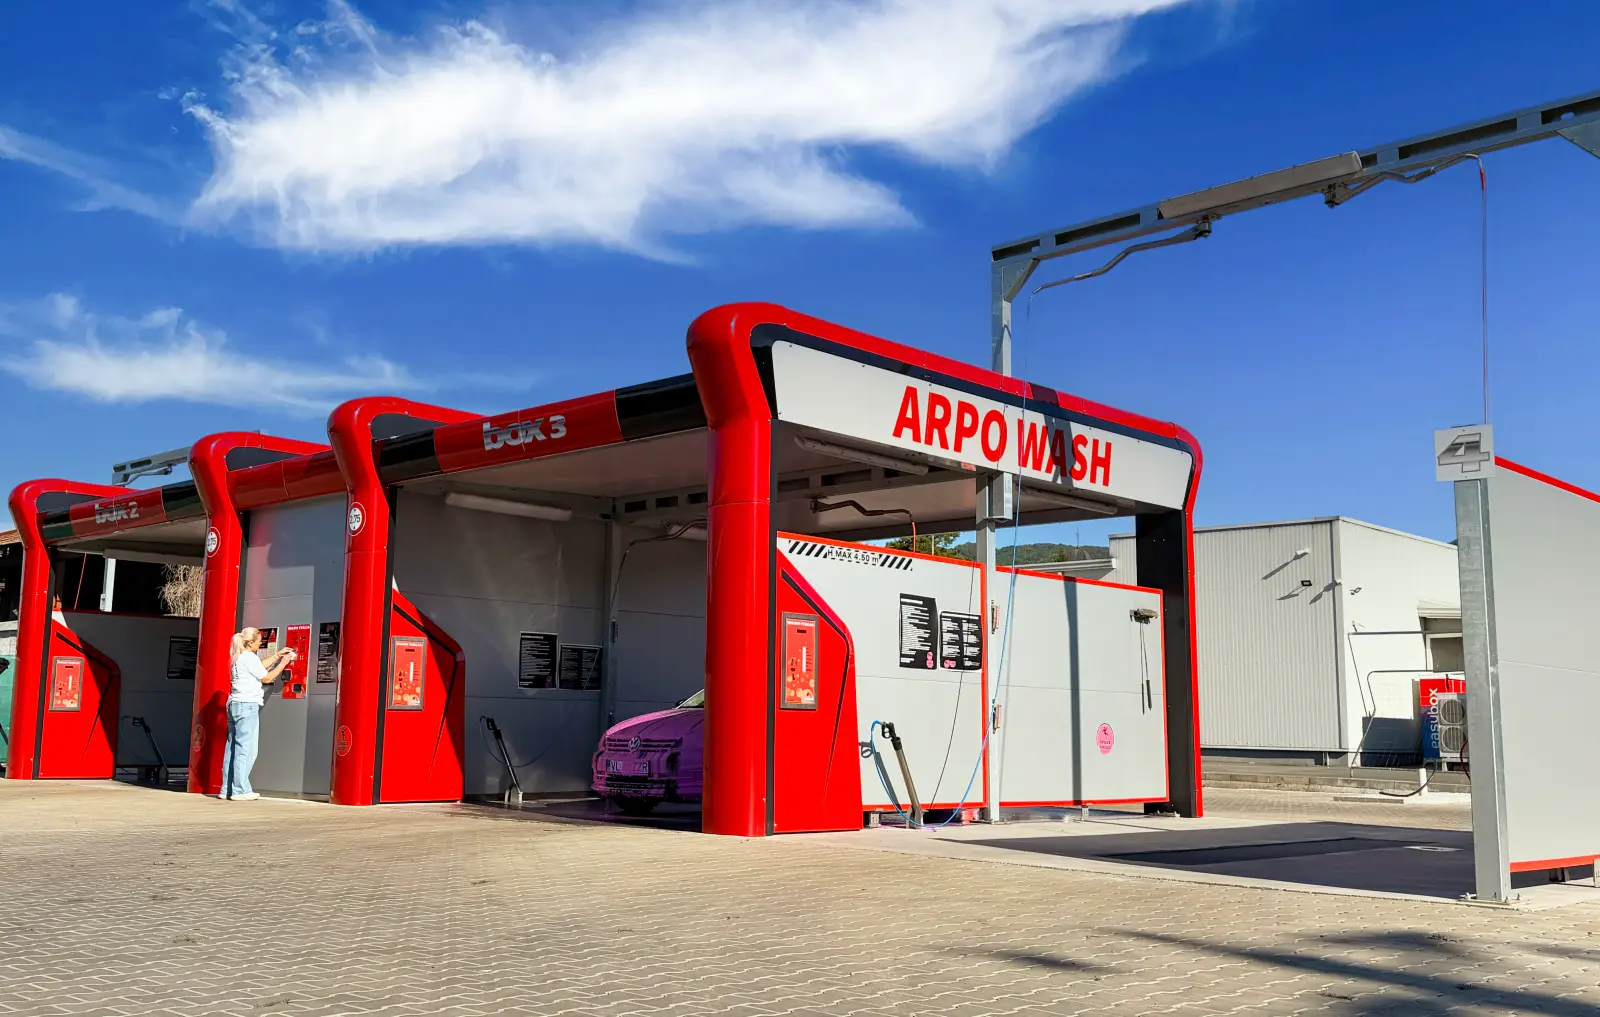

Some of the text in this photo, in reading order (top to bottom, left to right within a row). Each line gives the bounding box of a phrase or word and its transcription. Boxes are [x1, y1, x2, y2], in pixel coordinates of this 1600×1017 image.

[482, 415, 567, 451] box 3
[892, 385, 1113, 488] ARPO WASH
[1436, 432, 1491, 473] 4
[94, 501, 140, 524] box 2
[828, 549, 834, 557] H
[836, 550, 853, 560] MAX
[854, 553, 870, 562] 4.50
